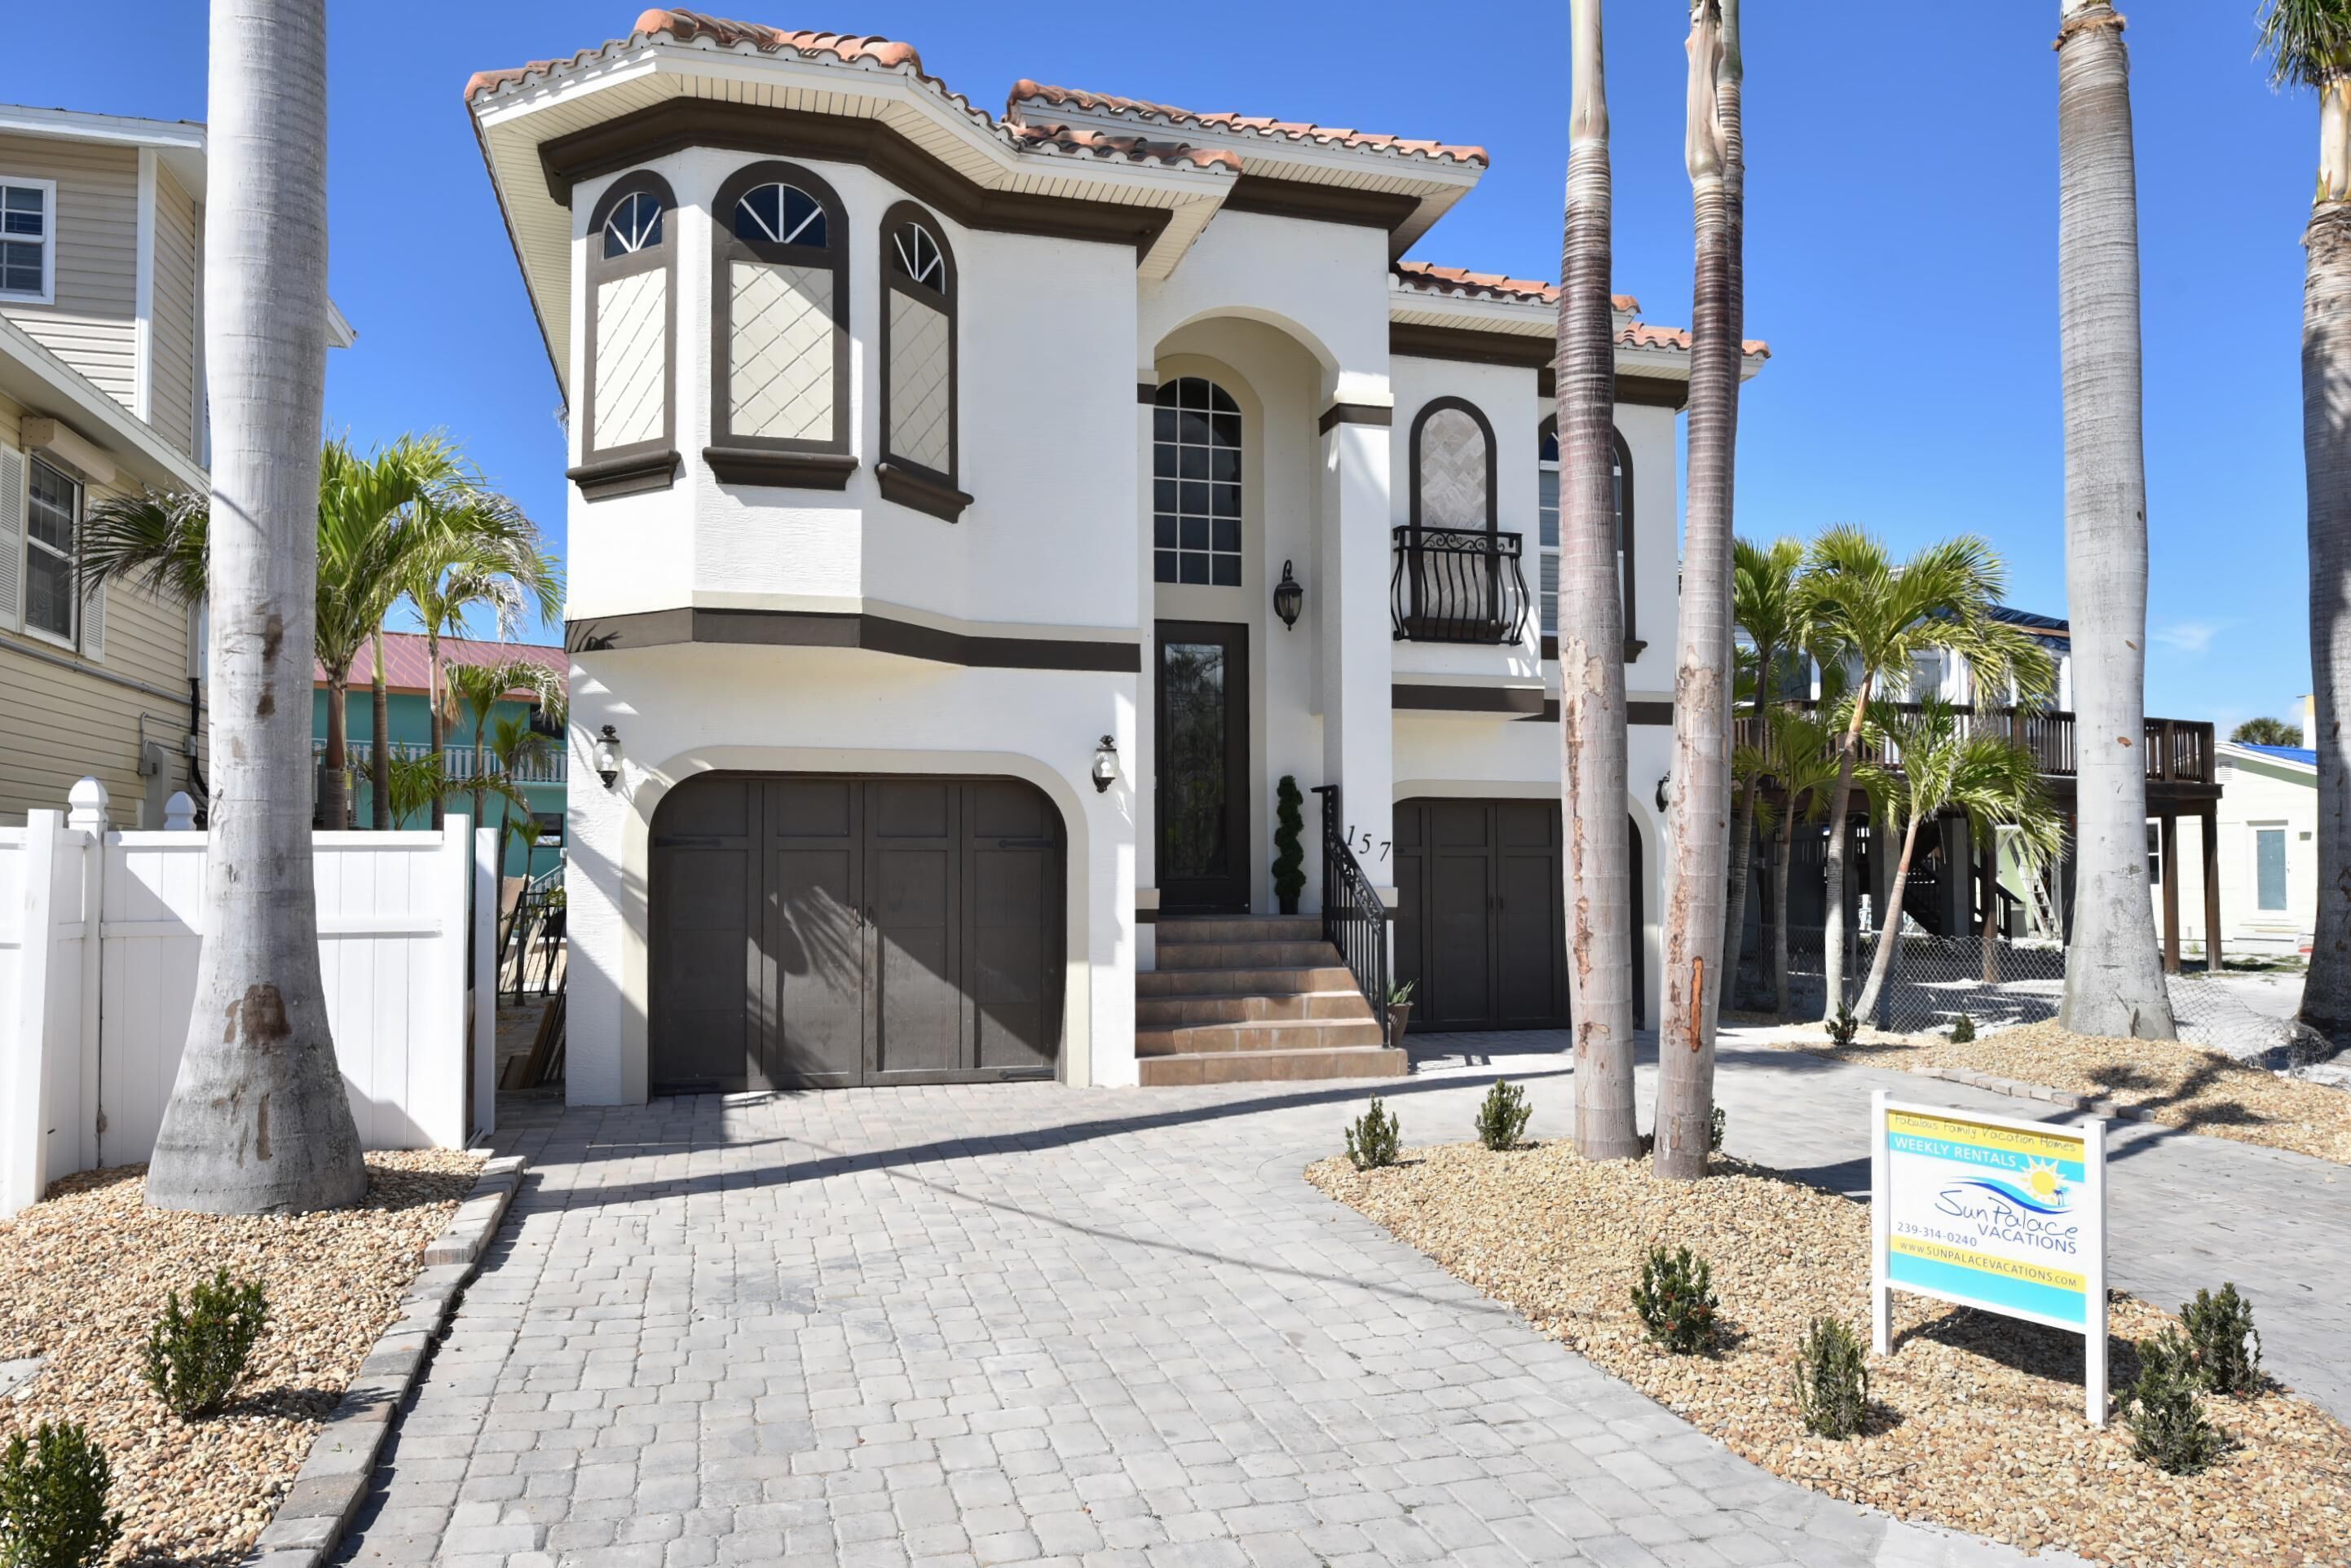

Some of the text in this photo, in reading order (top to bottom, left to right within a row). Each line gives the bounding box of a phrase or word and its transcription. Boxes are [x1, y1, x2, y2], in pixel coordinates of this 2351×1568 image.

[1347, 825, 1392, 862] 157
[1895, 1112, 2076, 1152] Fabulous Family Vacation Homes
[1894, 1136, 2017, 1168] WEEKLY RENTALS
[1897, 1222, 1978, 1247] 239-314-0240
[1978, 1223, 2077, 1255] VACATIONS
